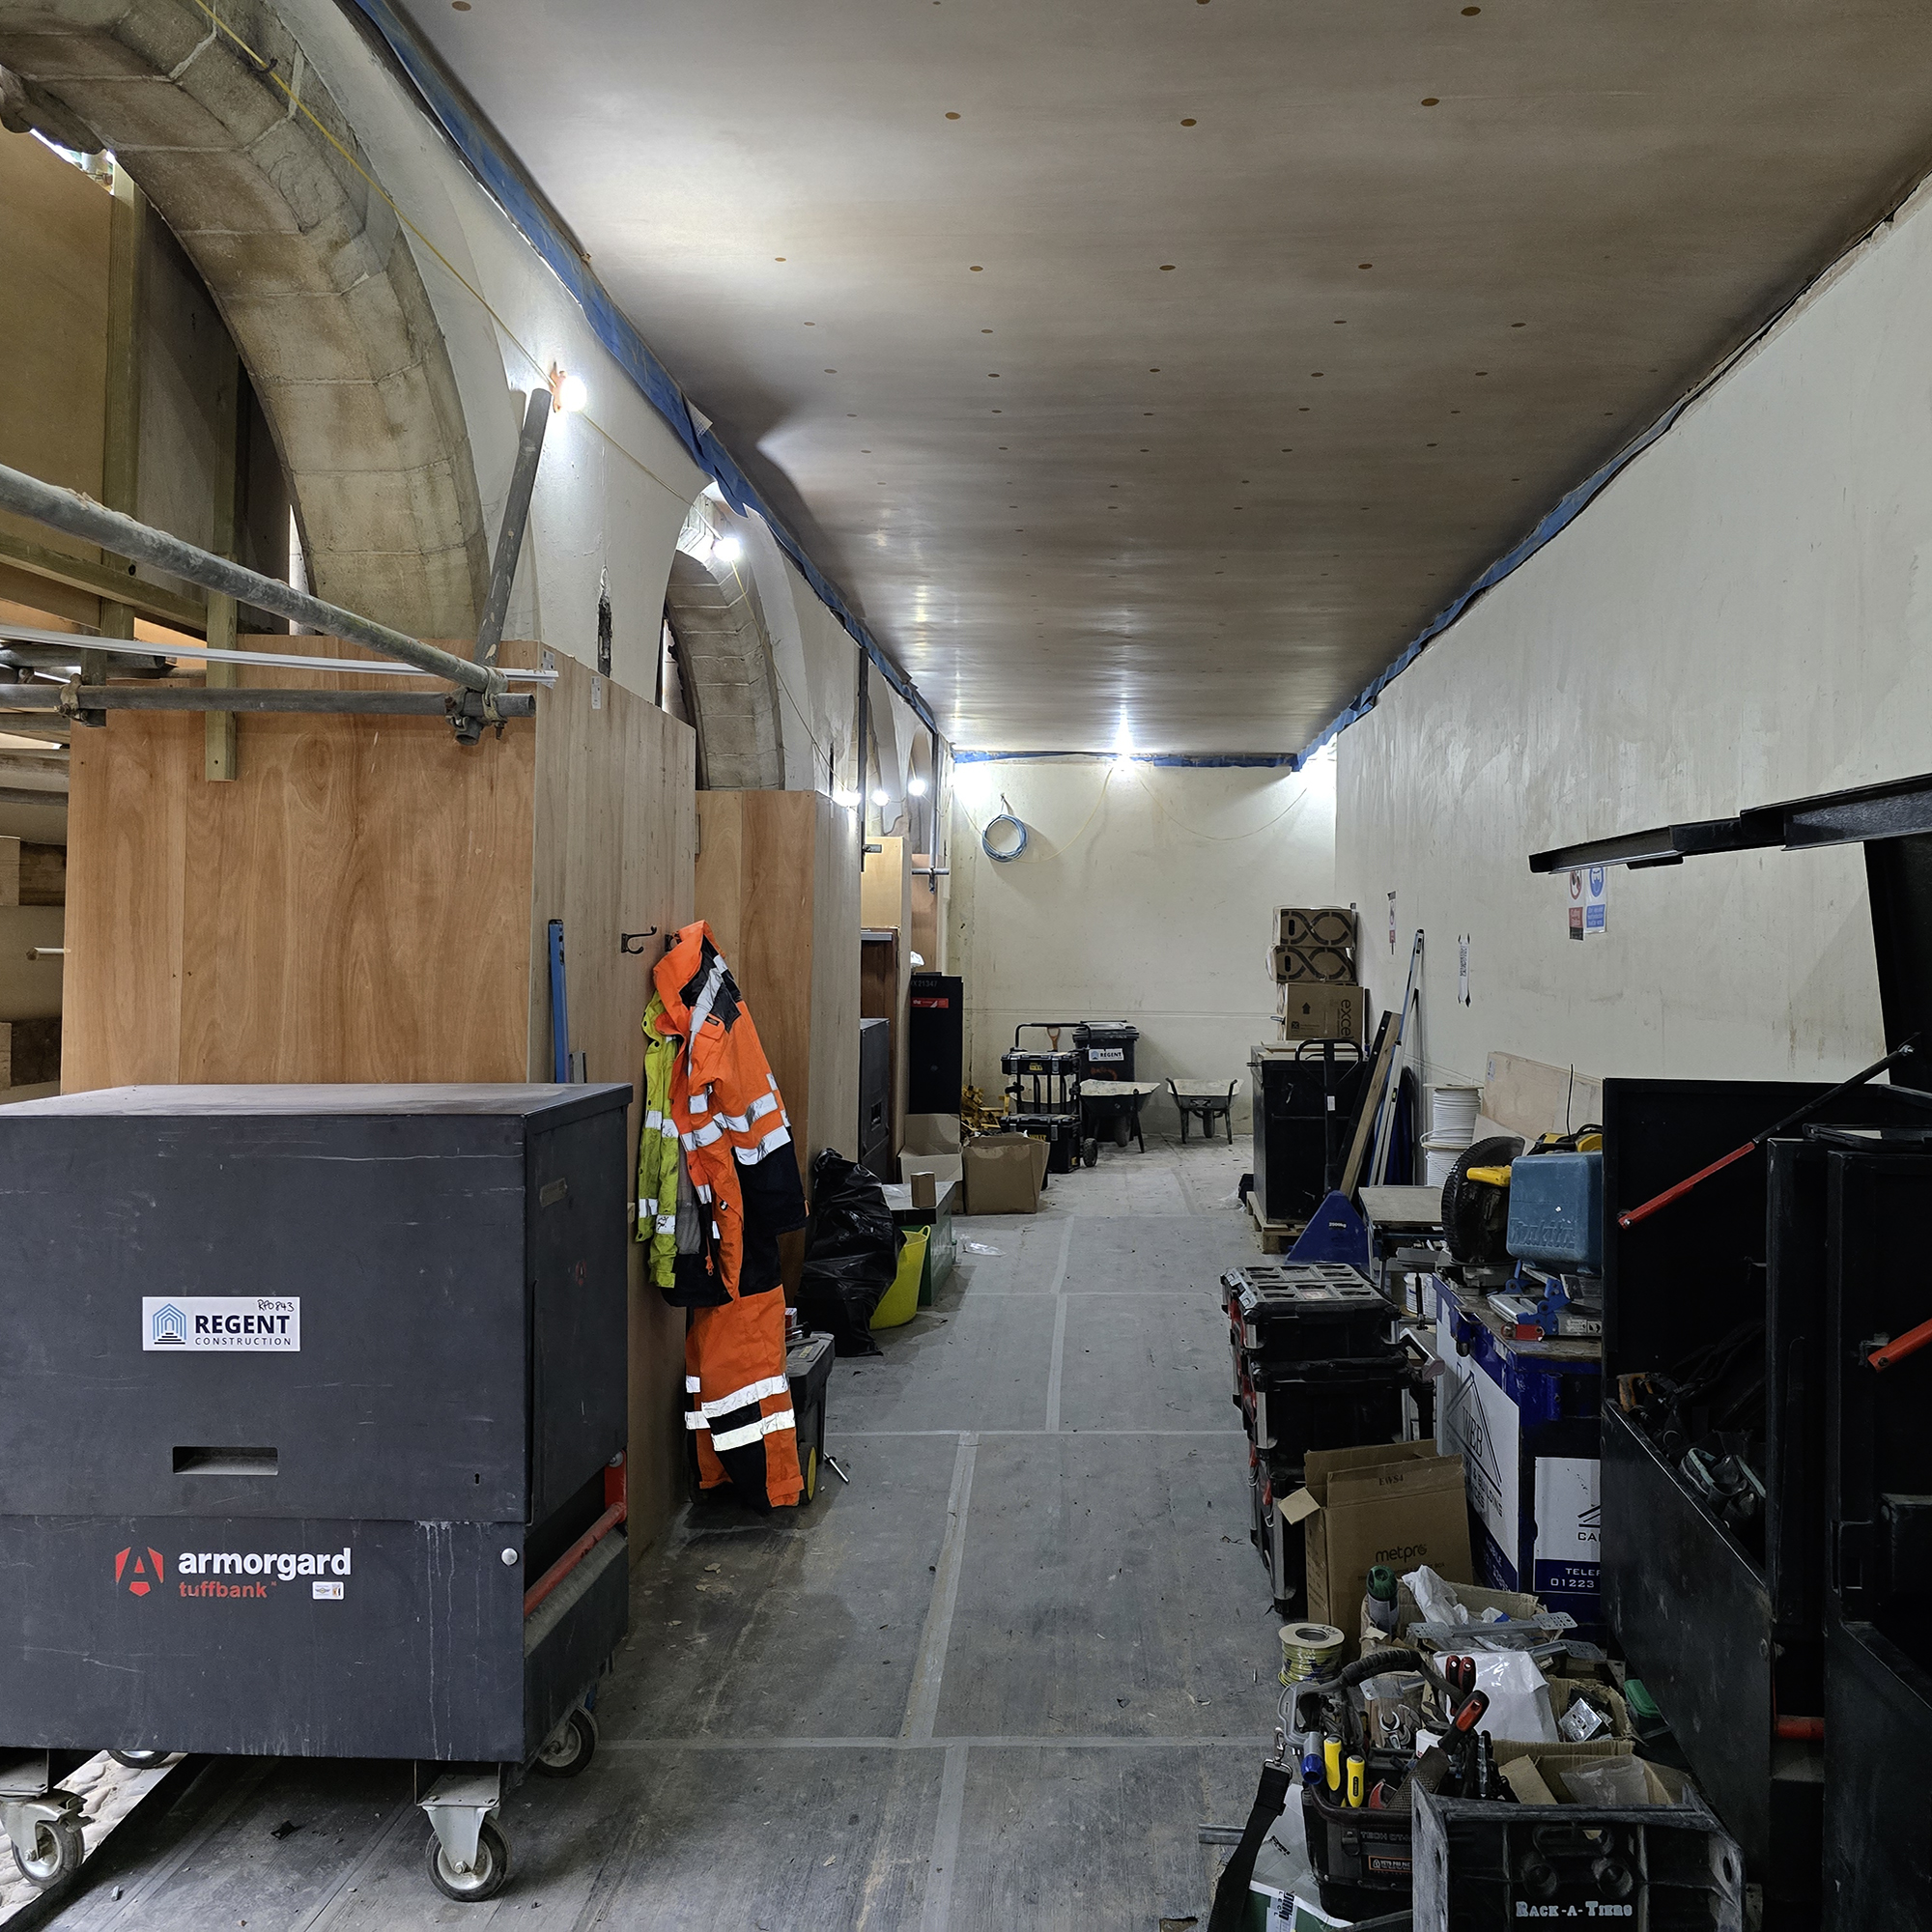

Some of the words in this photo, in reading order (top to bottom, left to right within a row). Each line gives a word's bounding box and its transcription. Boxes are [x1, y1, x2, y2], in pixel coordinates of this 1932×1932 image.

[195, 1315, 290, 1334] REGENT
[195, 1337, 291, 1346] CONSTRUCTION
[1577, 1532, 1601, 1542] CA
[179, 1548, 351, 1580] armorgard
[179, 1581, 268, 1598] tuffbank
[1550, 1578, 1595, 1588] 01223
